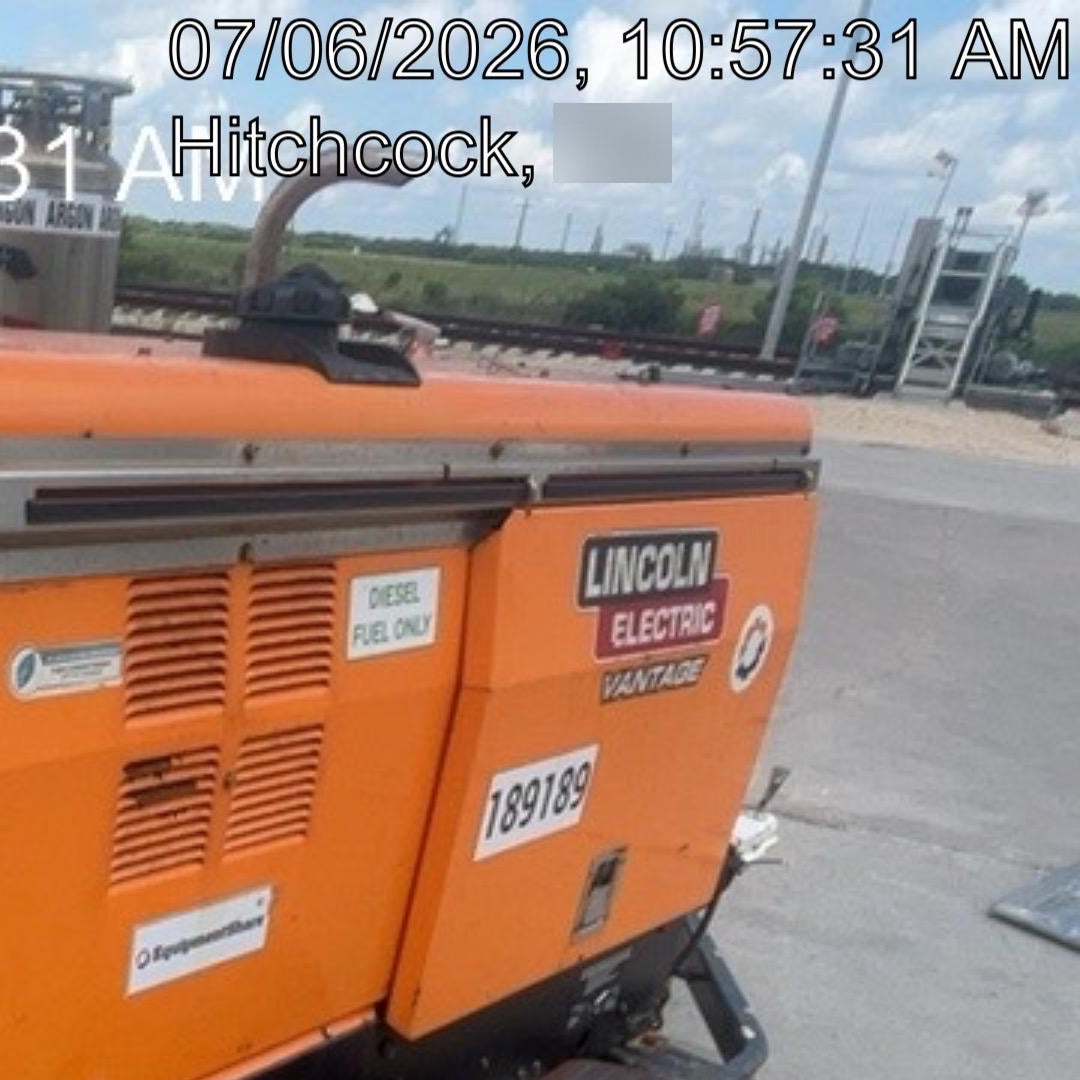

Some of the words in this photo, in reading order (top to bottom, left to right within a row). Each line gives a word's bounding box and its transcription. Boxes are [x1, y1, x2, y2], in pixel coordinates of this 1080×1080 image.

[46, 199, 95, 231] ARGON
[584, 541, 711, 598] LINCOLN
[368, 581, 421, 610] DIESEL
[352, 620, 390, 648] FUEL
[392, 611, 433, 641] ONLY
[610, 602, 716, 648] ELECTRIC
[602, 659, 705, 699] VANTAGE
[486, 761, 591, 838] 189189
[152, 914, 265, 962] EquipmentShare
